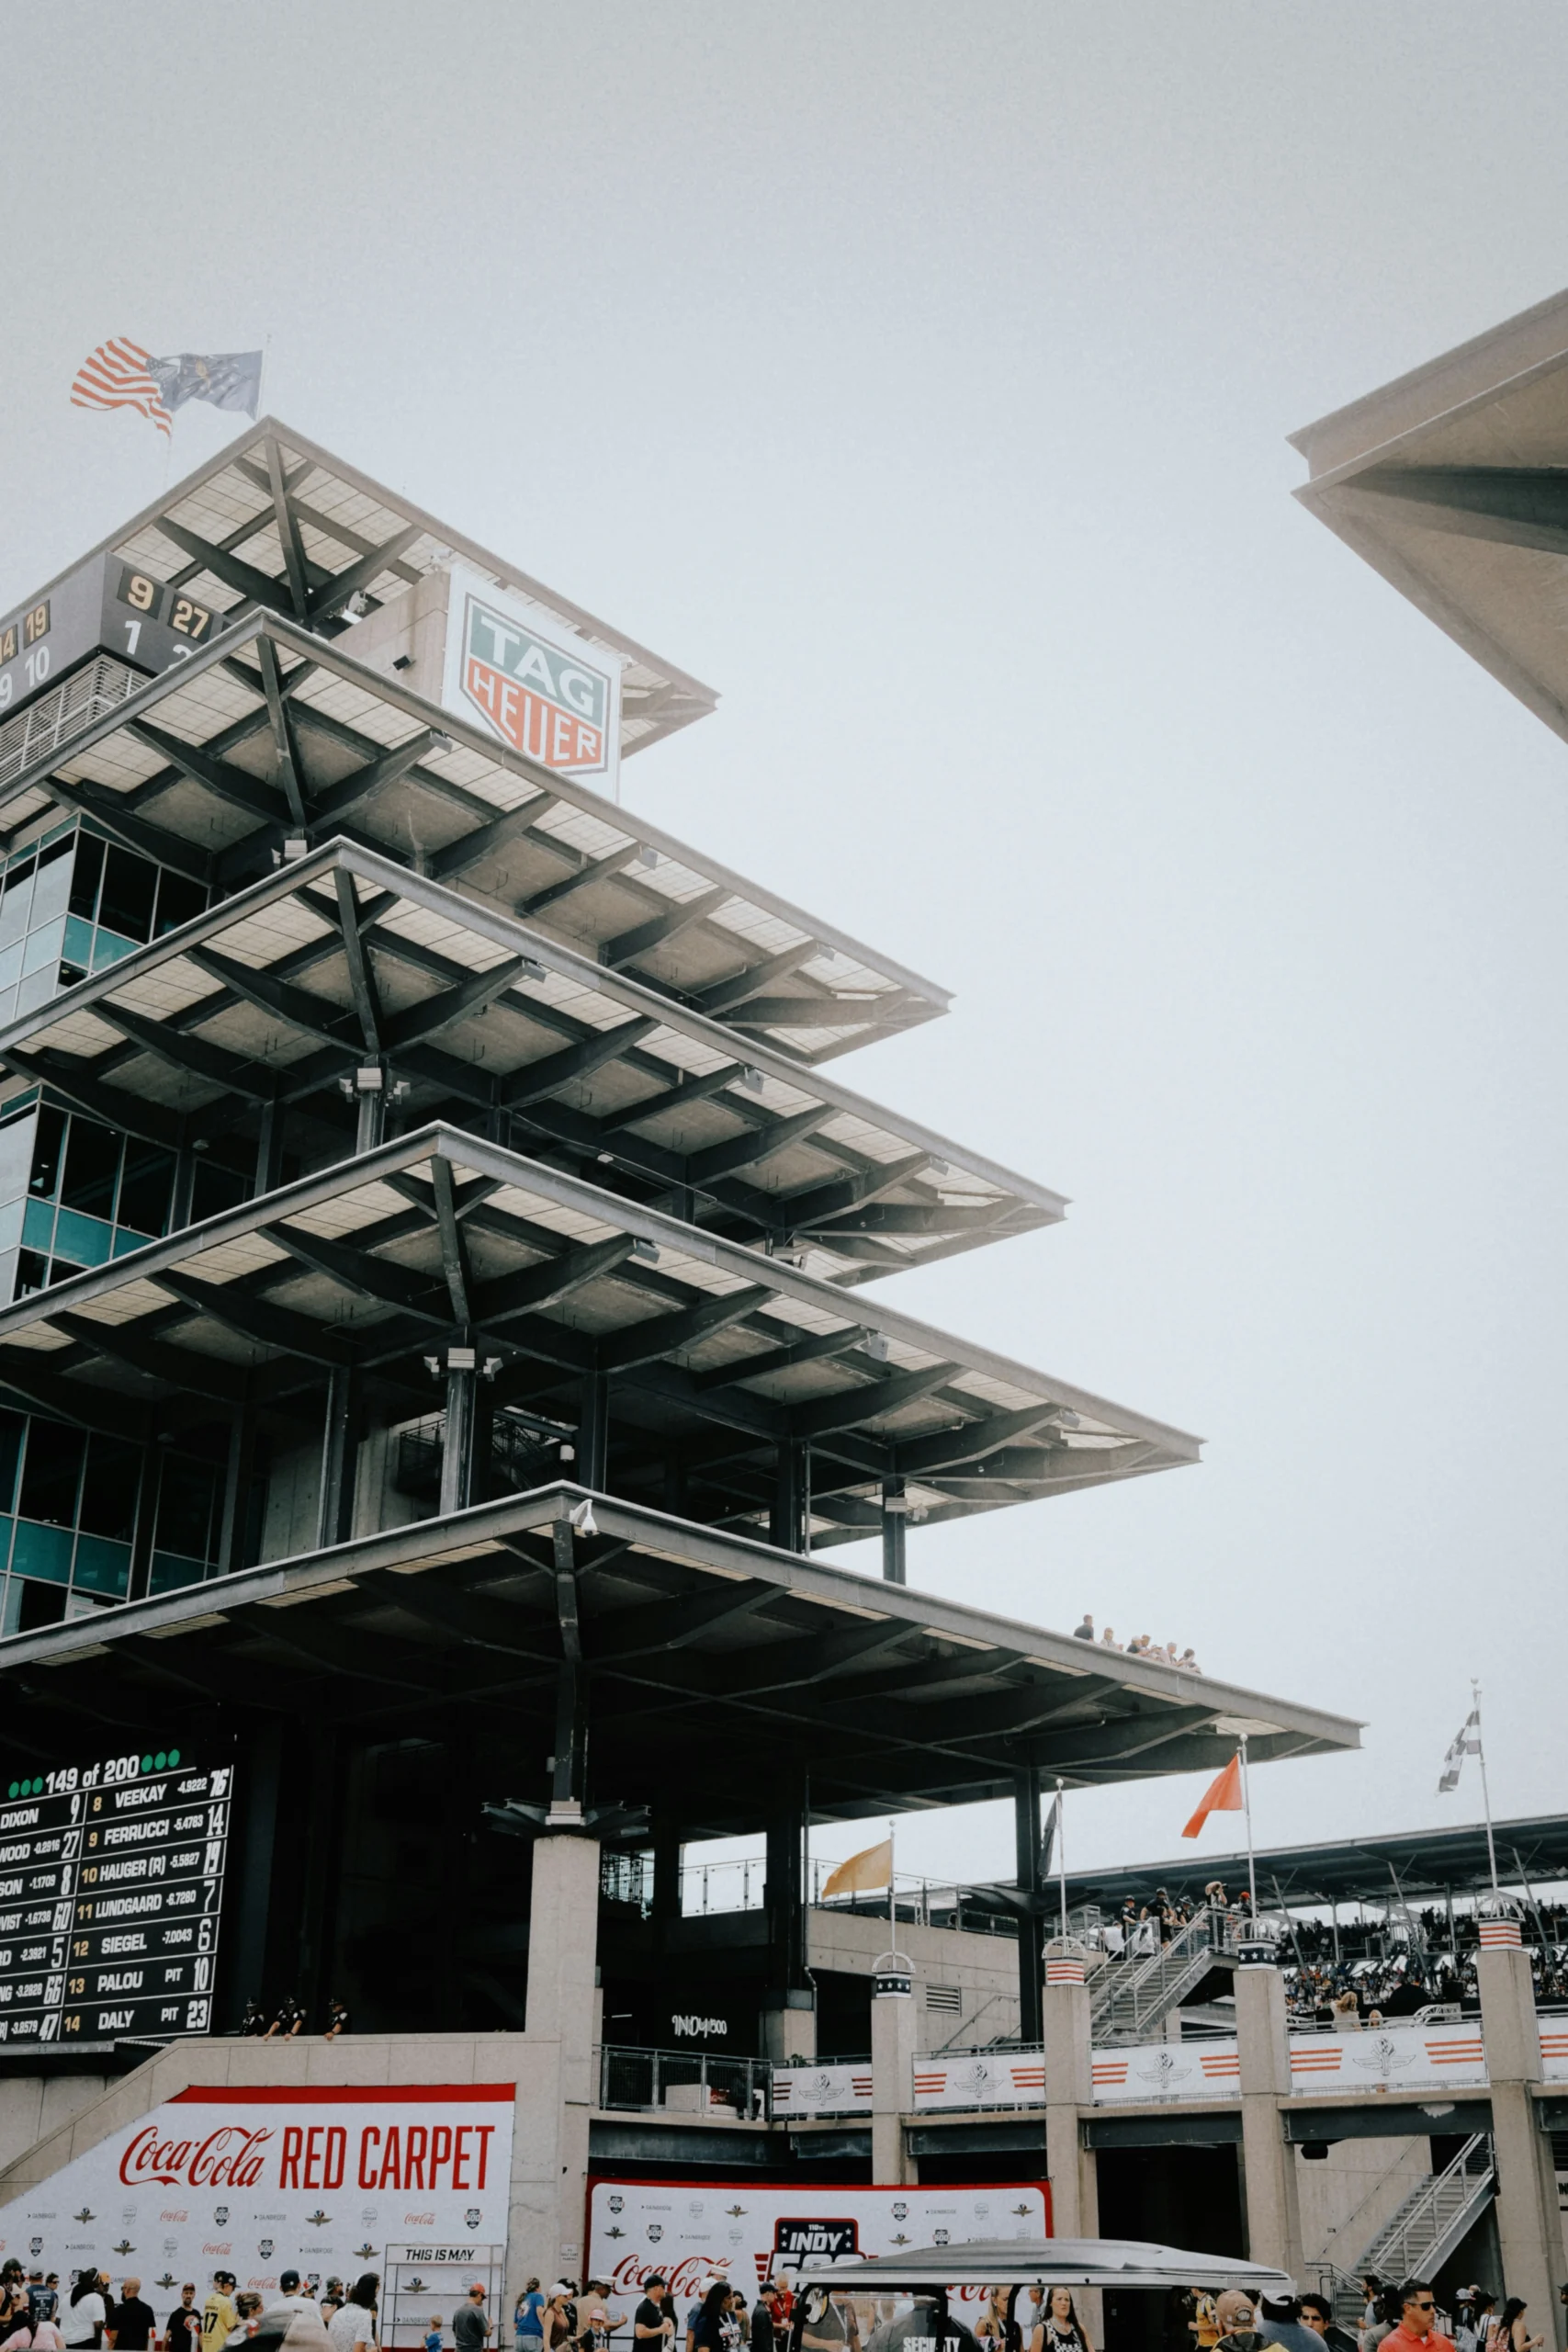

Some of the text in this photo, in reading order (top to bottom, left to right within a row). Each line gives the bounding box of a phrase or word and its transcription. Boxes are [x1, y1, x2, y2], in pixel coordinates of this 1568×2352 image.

[26, 605, 46, 642] 19
[128, 575, 209, 638] 9 27
[125, 620, 141, 655] 1
[25, 646, 50, 687] 10
[480, 615, 594, 717] TAG
[473, 665, 596, 762] HEUER
[45, 1755, 140, 1794] 149 of 200
[93, 1768, 231, 1812] 8 VEEKAY -4.9222 76
[0, 1793, 81, 1829] DIXON 9
[88, 1804, 224, 1848] 9 FERRUCCI -5.4783 14
[34, 1838, 61, 1854] -0.2916
[61, 1830, 80, 1860] 27
[82, 1840, 221, 1883] 10 HAUGER (R) -5.5827 19
[29, 1874, 56, 1889] -1.1709
[61, 1864, 73, 1895] 8
[25, 1910, 51, 1926] -1.6738
[51, 1902, 72, 1931] 60
[77, 1879, 216, 1920] 11 LUNDGAARD -6.7280 7
[20, 1946, 47, 1962] -2.3921
[51, 1937, 65, 1968] 5
[73, 1918, 211, 1957] 12 SIEGEL -7.0043 6
[43, 1975, 63, 2005] 66
[68, 1957, 209, 1995] 13 PALOU PIT 10
[11, 2020, 39, 2035] -3.8579
[39, 2013, 60, 2041] 47
[64, 1999, 208, 2032] 14 DALY PIT 23
[671, 2015, 728, 2039] INDY 500
[279, 2126, 347, 2189] RED
[357, 2125, 495, 2190] CARPET
[406, 2248, 433, 2261] THIS
[434, 2248, 446, 2261] IS
[789, 2232, 843, 2252] INDY
[204, 2312, 219, 2334] 17
[903, 2336, 961, 2352] SECUTY
